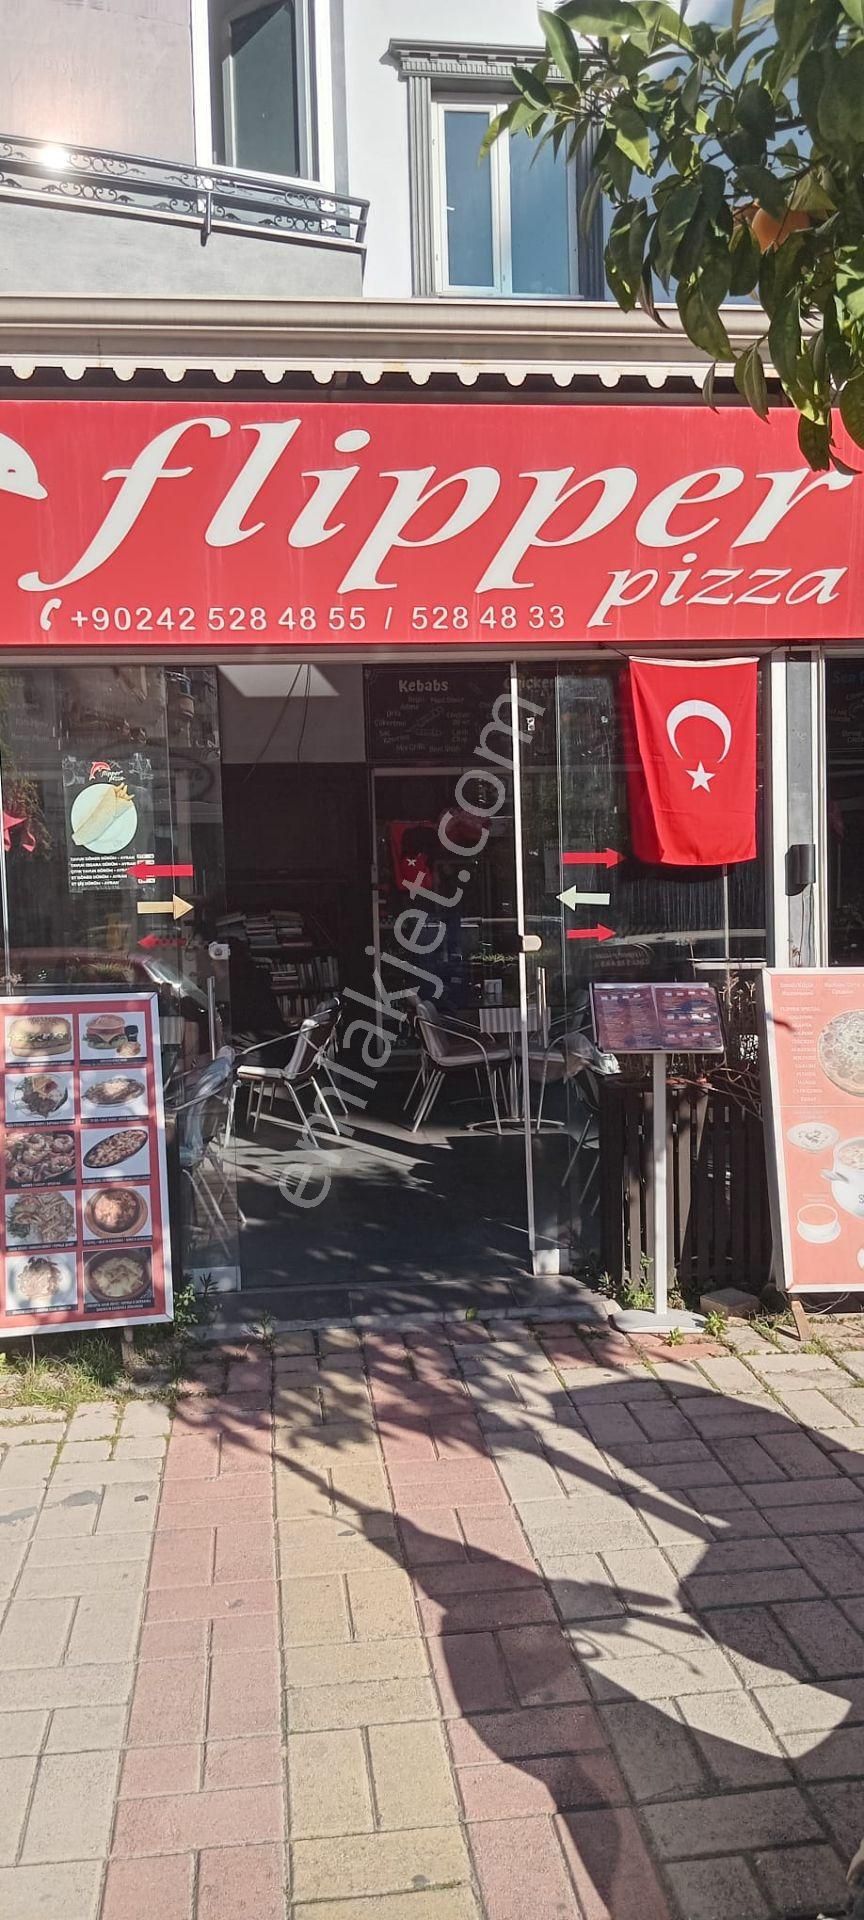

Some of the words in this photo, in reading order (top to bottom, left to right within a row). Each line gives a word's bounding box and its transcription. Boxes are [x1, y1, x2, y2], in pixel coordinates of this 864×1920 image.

[17, 417, 855, 594] flipper
[587, 552, 848, 628] pizza
[70, 606, 197, 632] +90242
[207, 606, 268, 631] 528
[278, 606, 317, 630] 48
[327, 606, 367, 630] 55
[411, 605, 470, 630] 528
[478, 605, 518, 630] 48
[529, 604, 566, 630] 33
[398, 679, 449, 693] Kebabs
